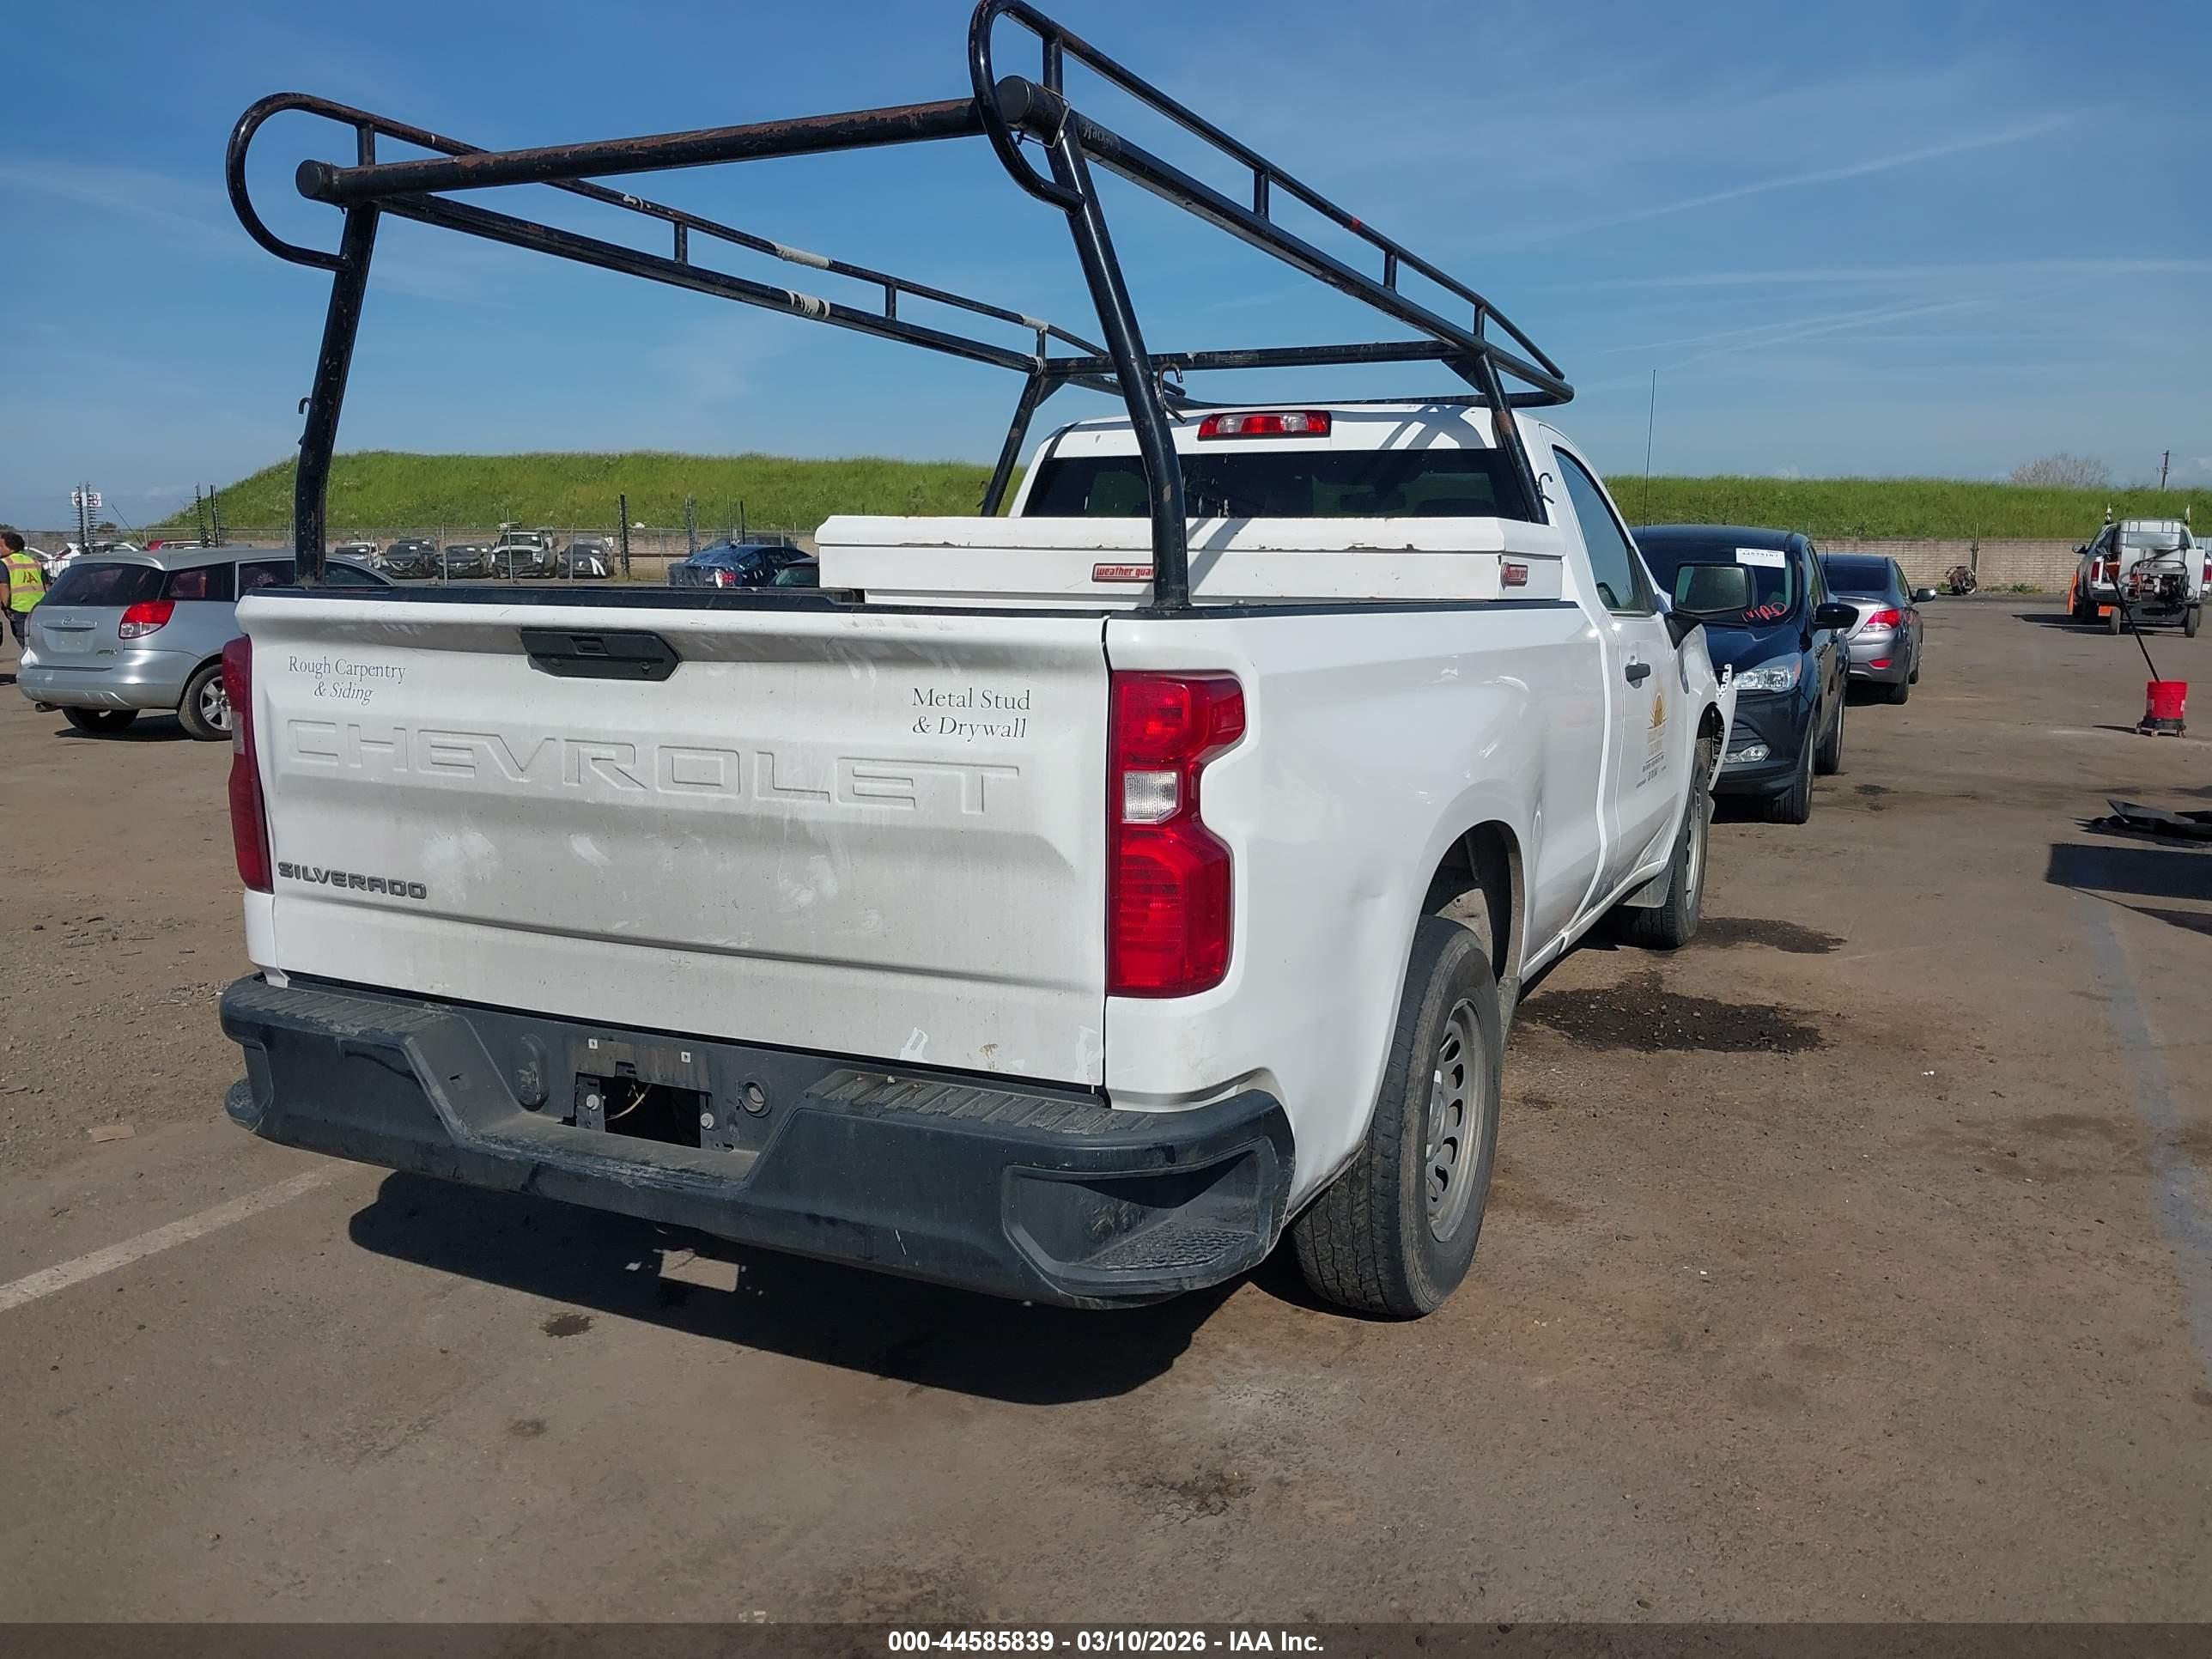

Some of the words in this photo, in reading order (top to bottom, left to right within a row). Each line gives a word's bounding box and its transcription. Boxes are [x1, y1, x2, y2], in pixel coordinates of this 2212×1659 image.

[1097, 567, 1133, 577] weather
[1135, 568, 1155, 579] guar
[289, 656, 331, 679] Rough
[335, 659, 405, 684] Carpentry
[314, 681, 326, 696] &
[330, 682, 374, 706] Siding
[913, 687, 973, 708] Metal
[981, 690, 1030, 710] Stud
[912, 715, 932, 734] &
[938, 716, 1026, 742] Drywall
[286, 719, 1020, 814] CHEVROLET
[277, 861, 427, 899] SILVERADO
